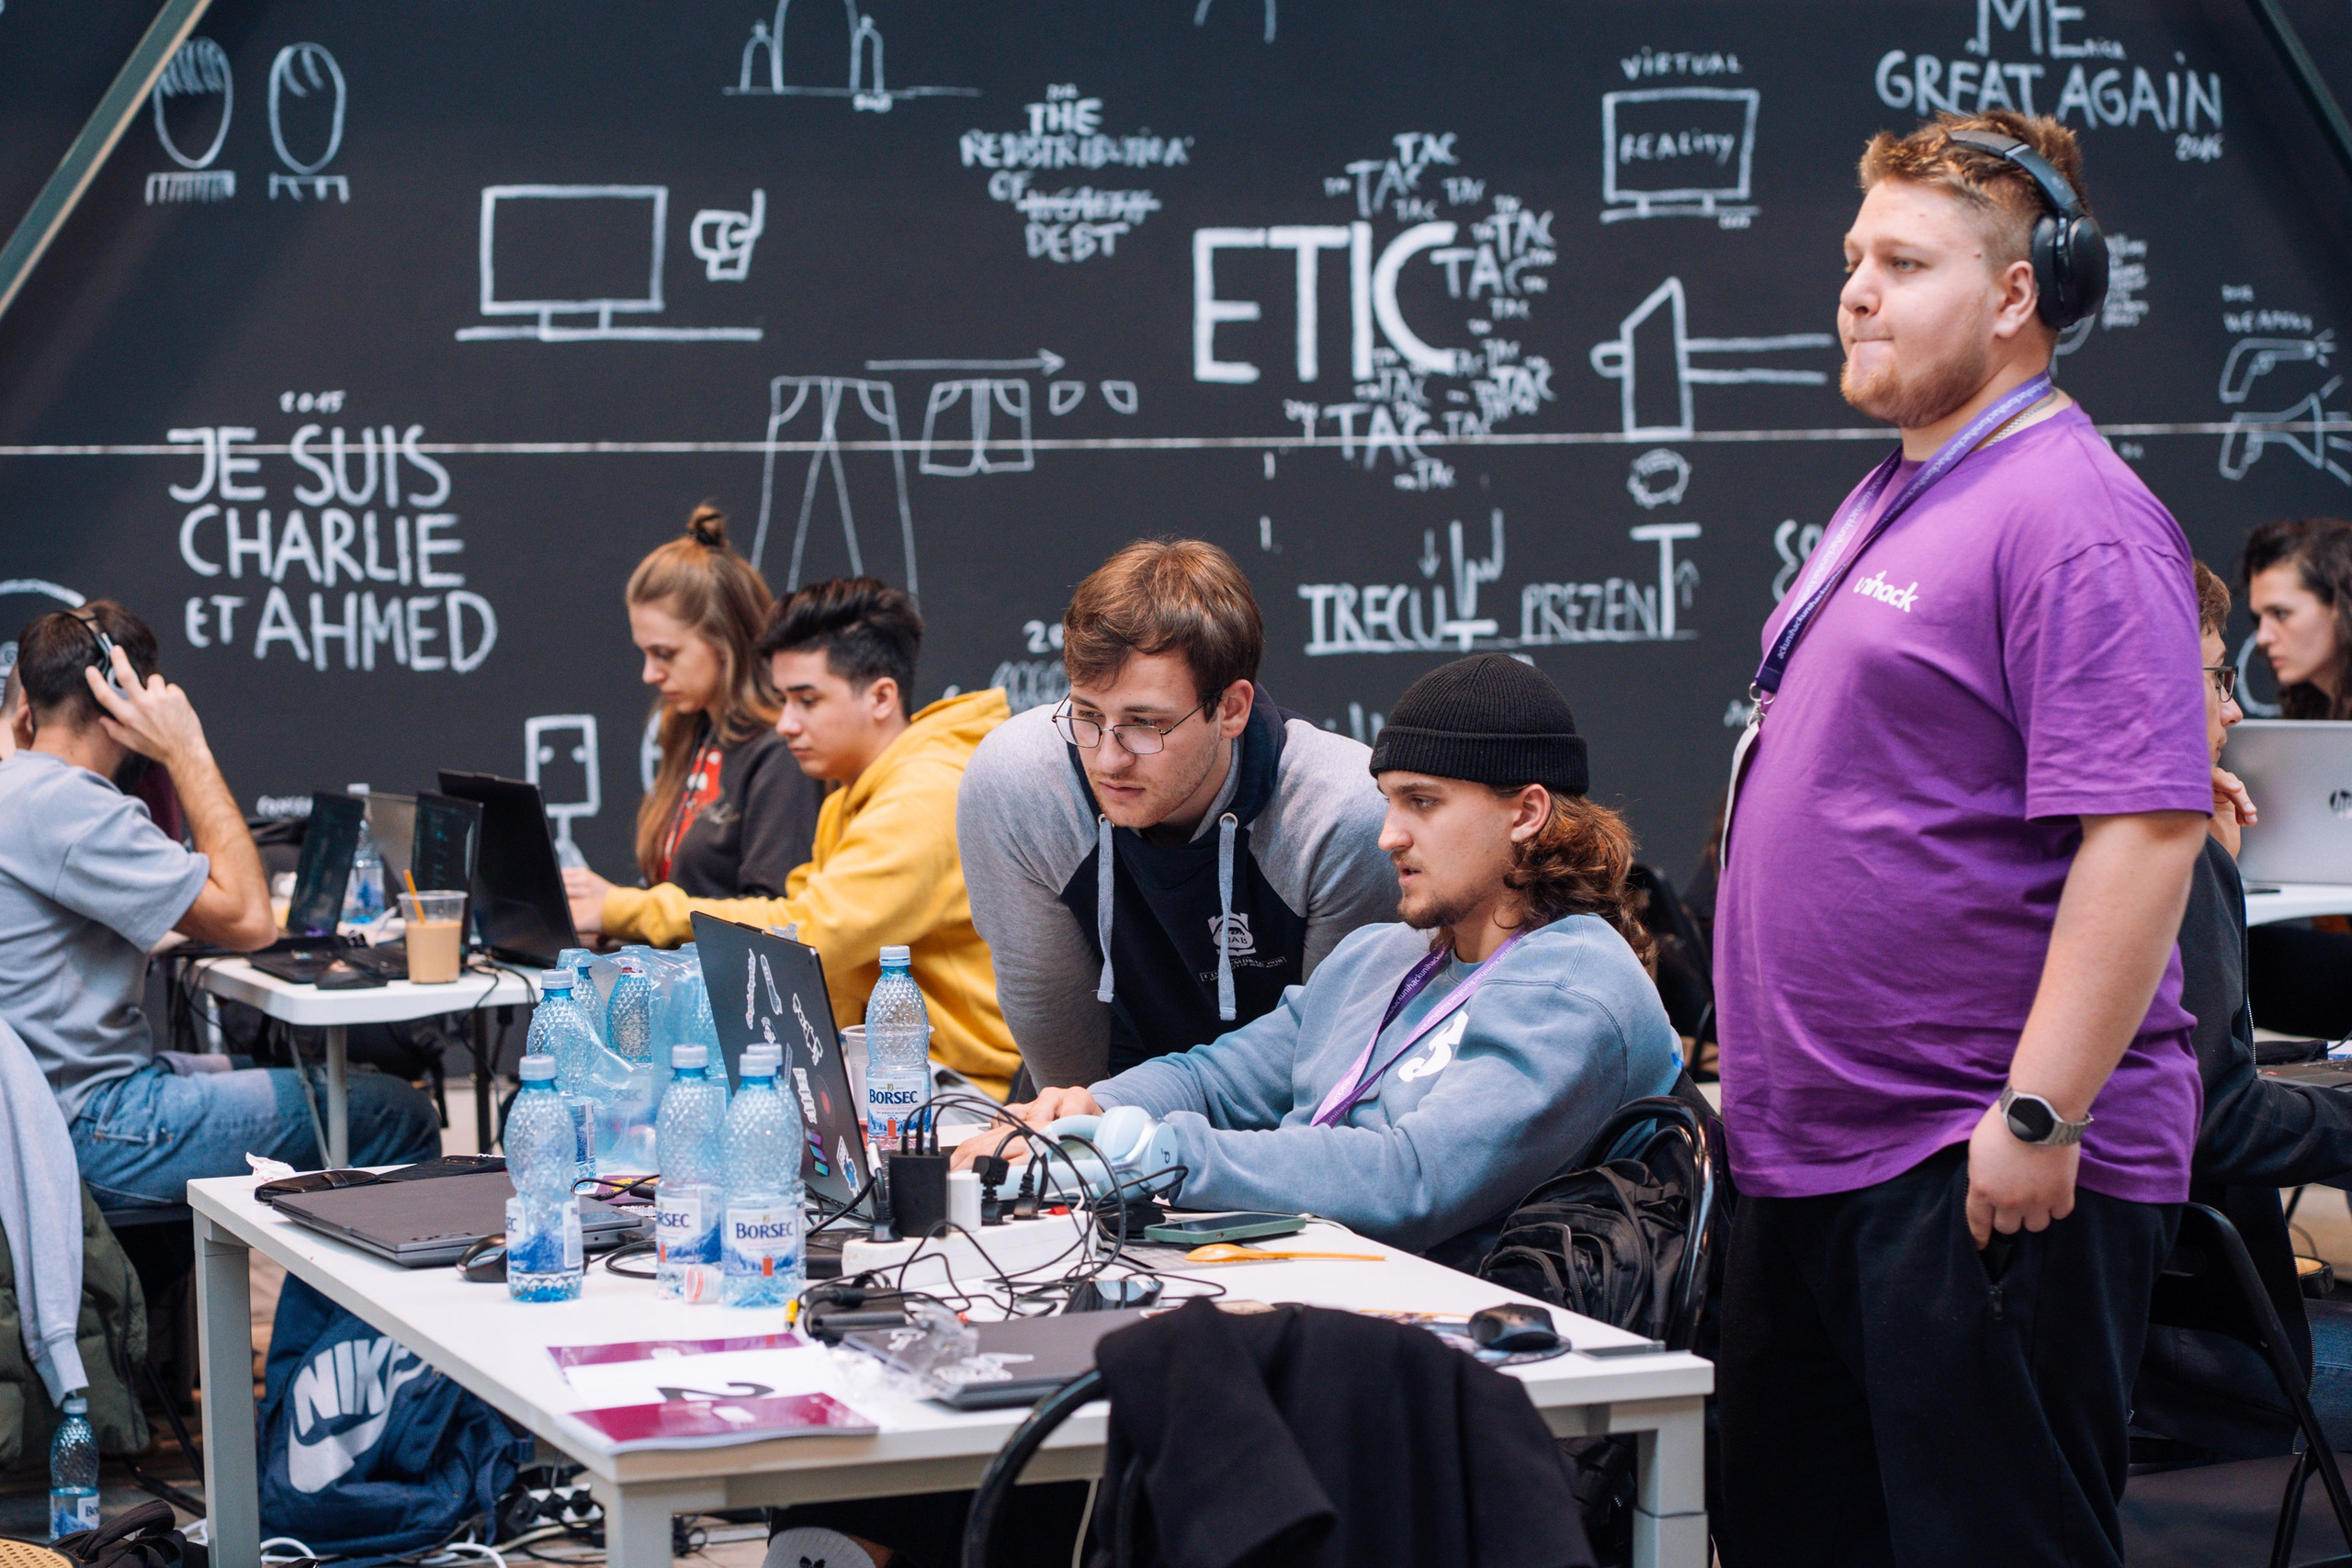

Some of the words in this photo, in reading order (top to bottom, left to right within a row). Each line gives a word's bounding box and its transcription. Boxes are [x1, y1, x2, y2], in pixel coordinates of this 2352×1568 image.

[1024, 97, 1102, 137] THE
[1875, 50, 2046, 119] GREAT
[1193, 220, 1459, 383] ETIC
[166, 426, 266, 502] JE
[288, 423, 451, 508] SUIS
[178, 503, 466, 587] CHARLIE
[186, 593, 247, 649] ET
[254, 590, 497, 674] AHMED
[869, 1089, 919, 1104] BORSEC
[736, 1223, 794, 1239] BORSEC
